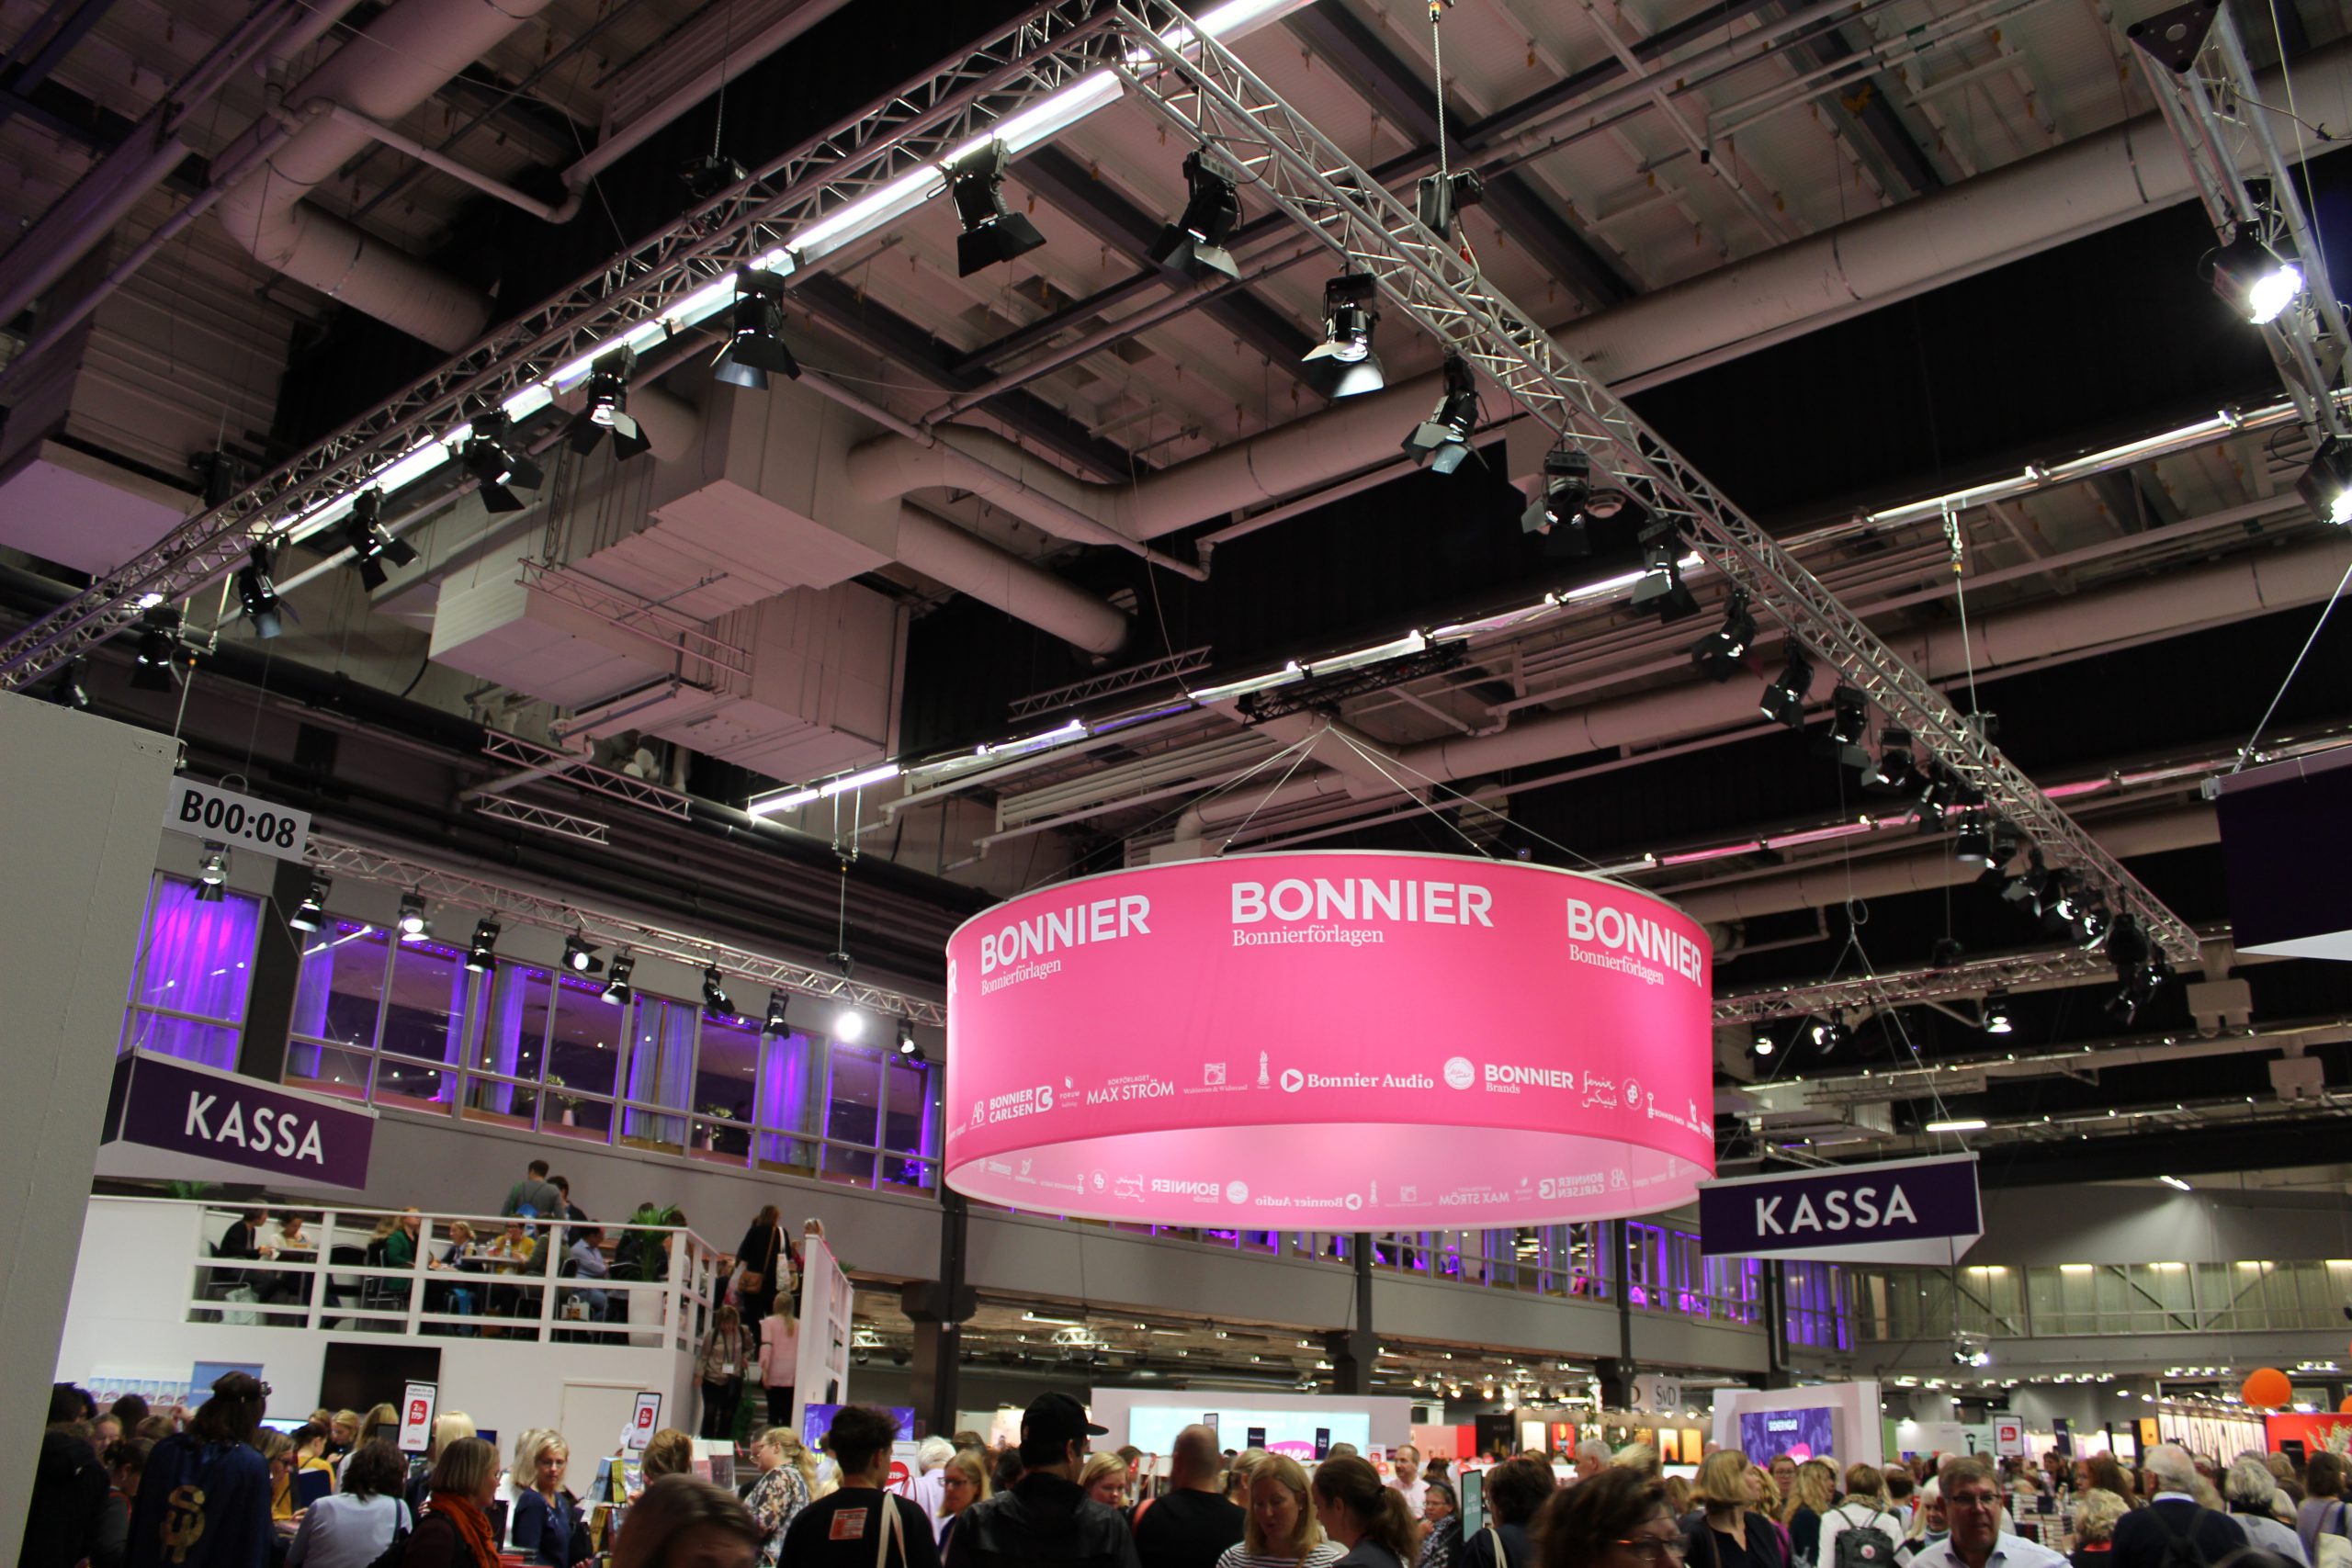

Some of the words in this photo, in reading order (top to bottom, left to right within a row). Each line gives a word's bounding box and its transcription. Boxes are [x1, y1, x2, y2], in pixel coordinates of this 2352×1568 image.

[179, 789, 297, 849] B00:08
[1232, 878, 1494, 927] BONNIER
[981, 895, 1151, 976] BONNIER
[1232, 925, 1385, 947] Bonnierförlagen
[1566, 897, 1702, 987] BONNIER
[981, 959, 1062, 997] Bonnierförlagen
[1569, 943, 1665, 986] Bonnierförlagen
[1086, 1087, 1119, 1106] MAX
[1122, 1078, 1175, 1101] STRÖM
[1307, 1072, 1379, 1089] Bonnier
[1382, 1073, 1434, 1089] Audio
[1485, 1064, 1574, 1089] BONNIER
[1486, 1081, 1521, 1094] Brands
[989, 1089, 1034, 1111] BONNIER
[989, 1103, 1034, 1124] CARLSEN
[184, 1090, 324, 1165] KASSA
[1756, 1184, 1917, 1236] KASSA
[1656, 1385, 1677, 1406] SvD
